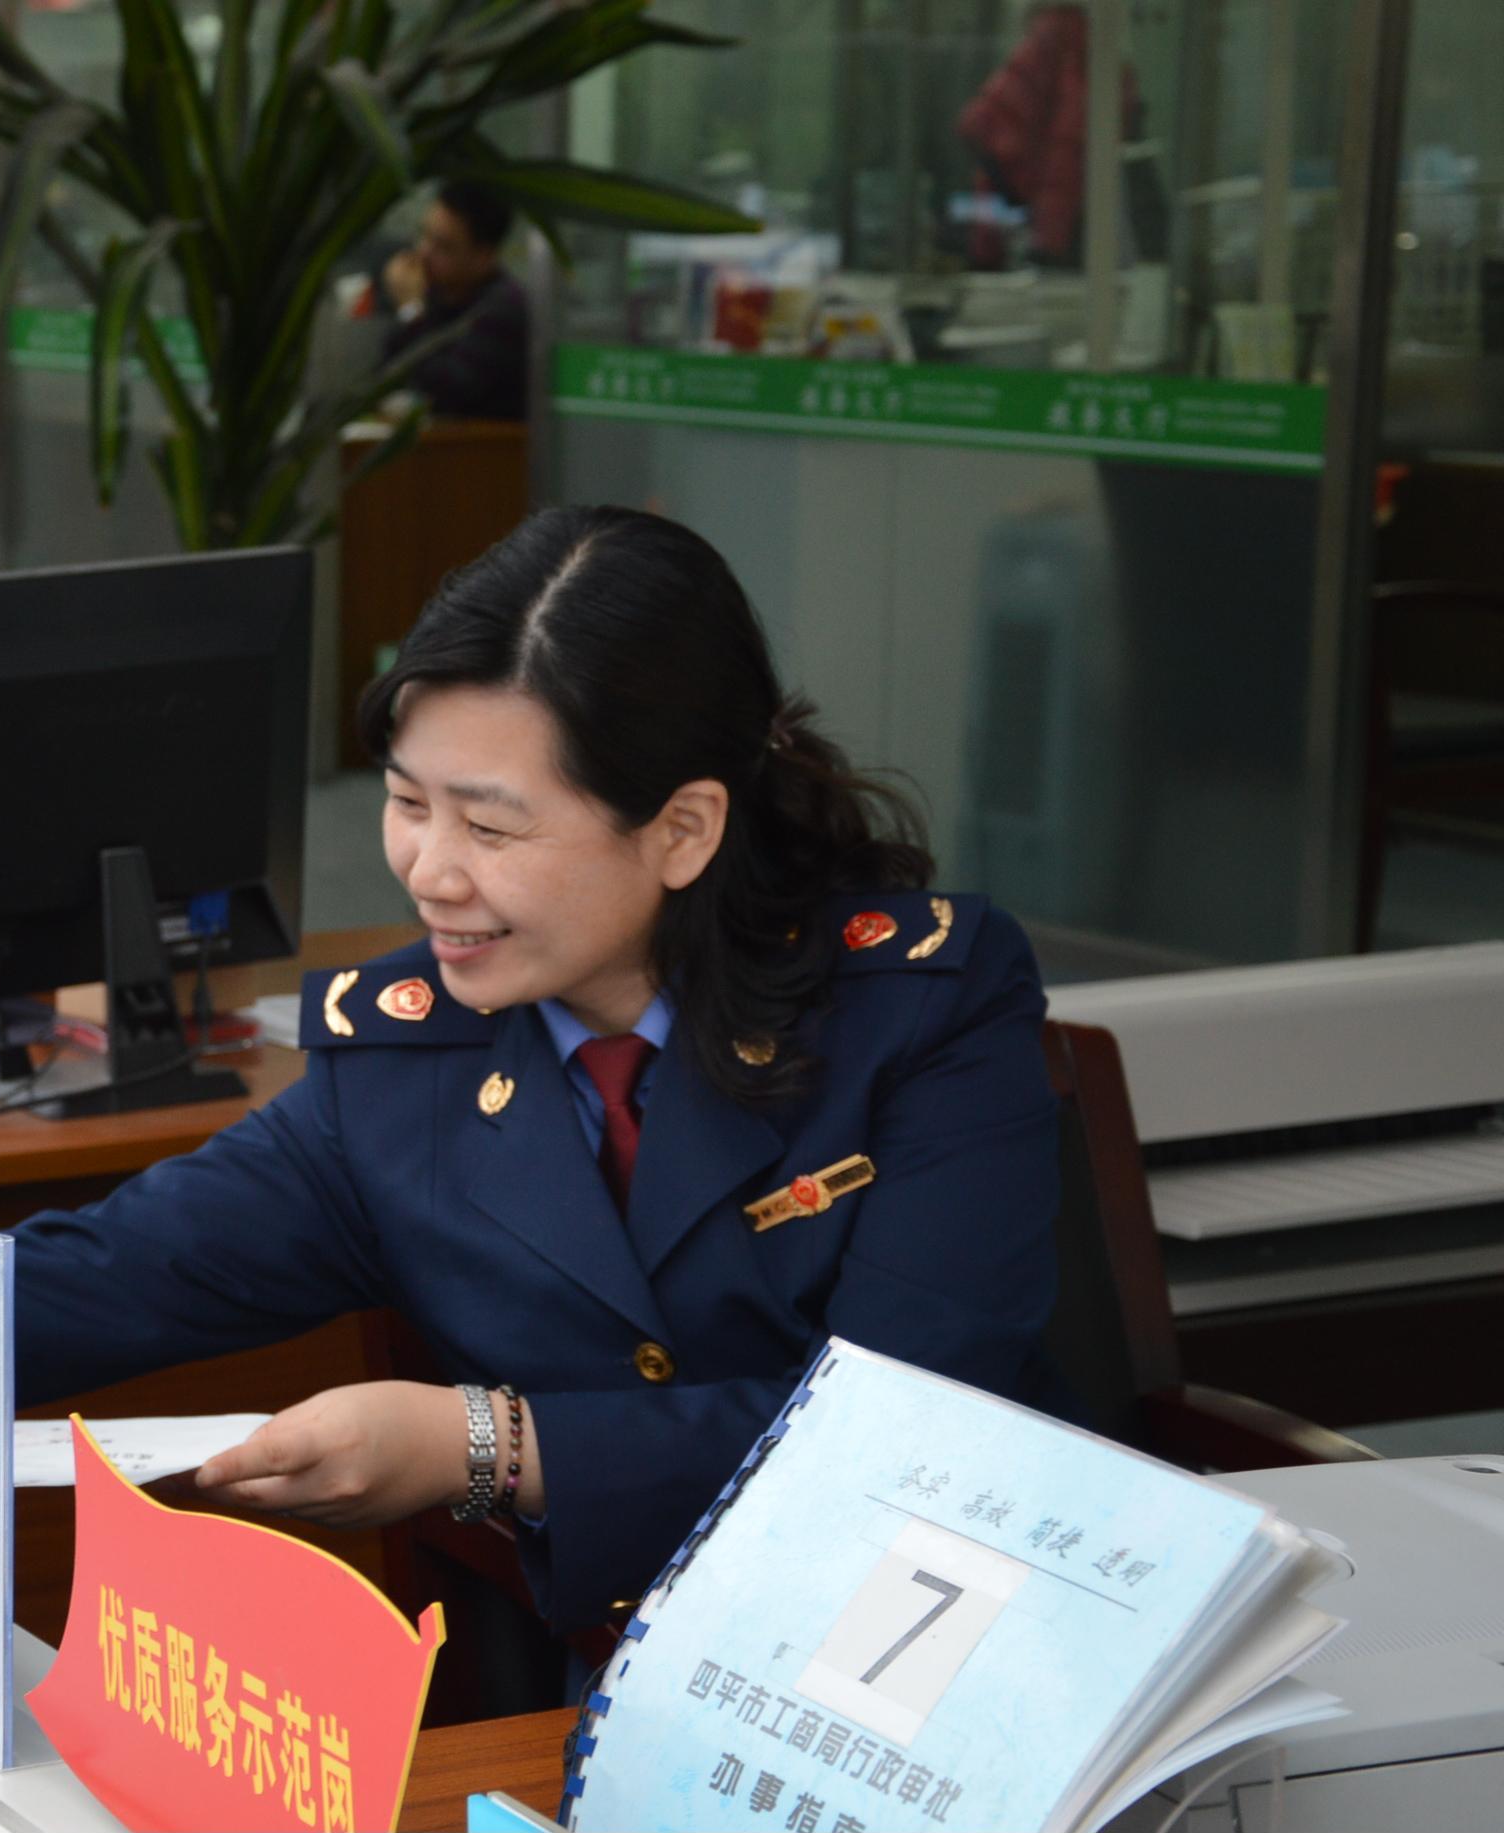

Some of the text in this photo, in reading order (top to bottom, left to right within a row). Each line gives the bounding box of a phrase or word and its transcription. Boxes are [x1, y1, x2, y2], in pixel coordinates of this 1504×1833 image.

[898, 1464, 951, 1500] 务实
[960, 1489, 1017, 1529] 高效
[1091, 1547, 1157, 1588] 透明
[859, 1568, 965, 1685] 7
[98, 1584, 355, 1833] 优质服务示范岗
[686, 1658, 963, 1823] 四平市工商局行政审批
